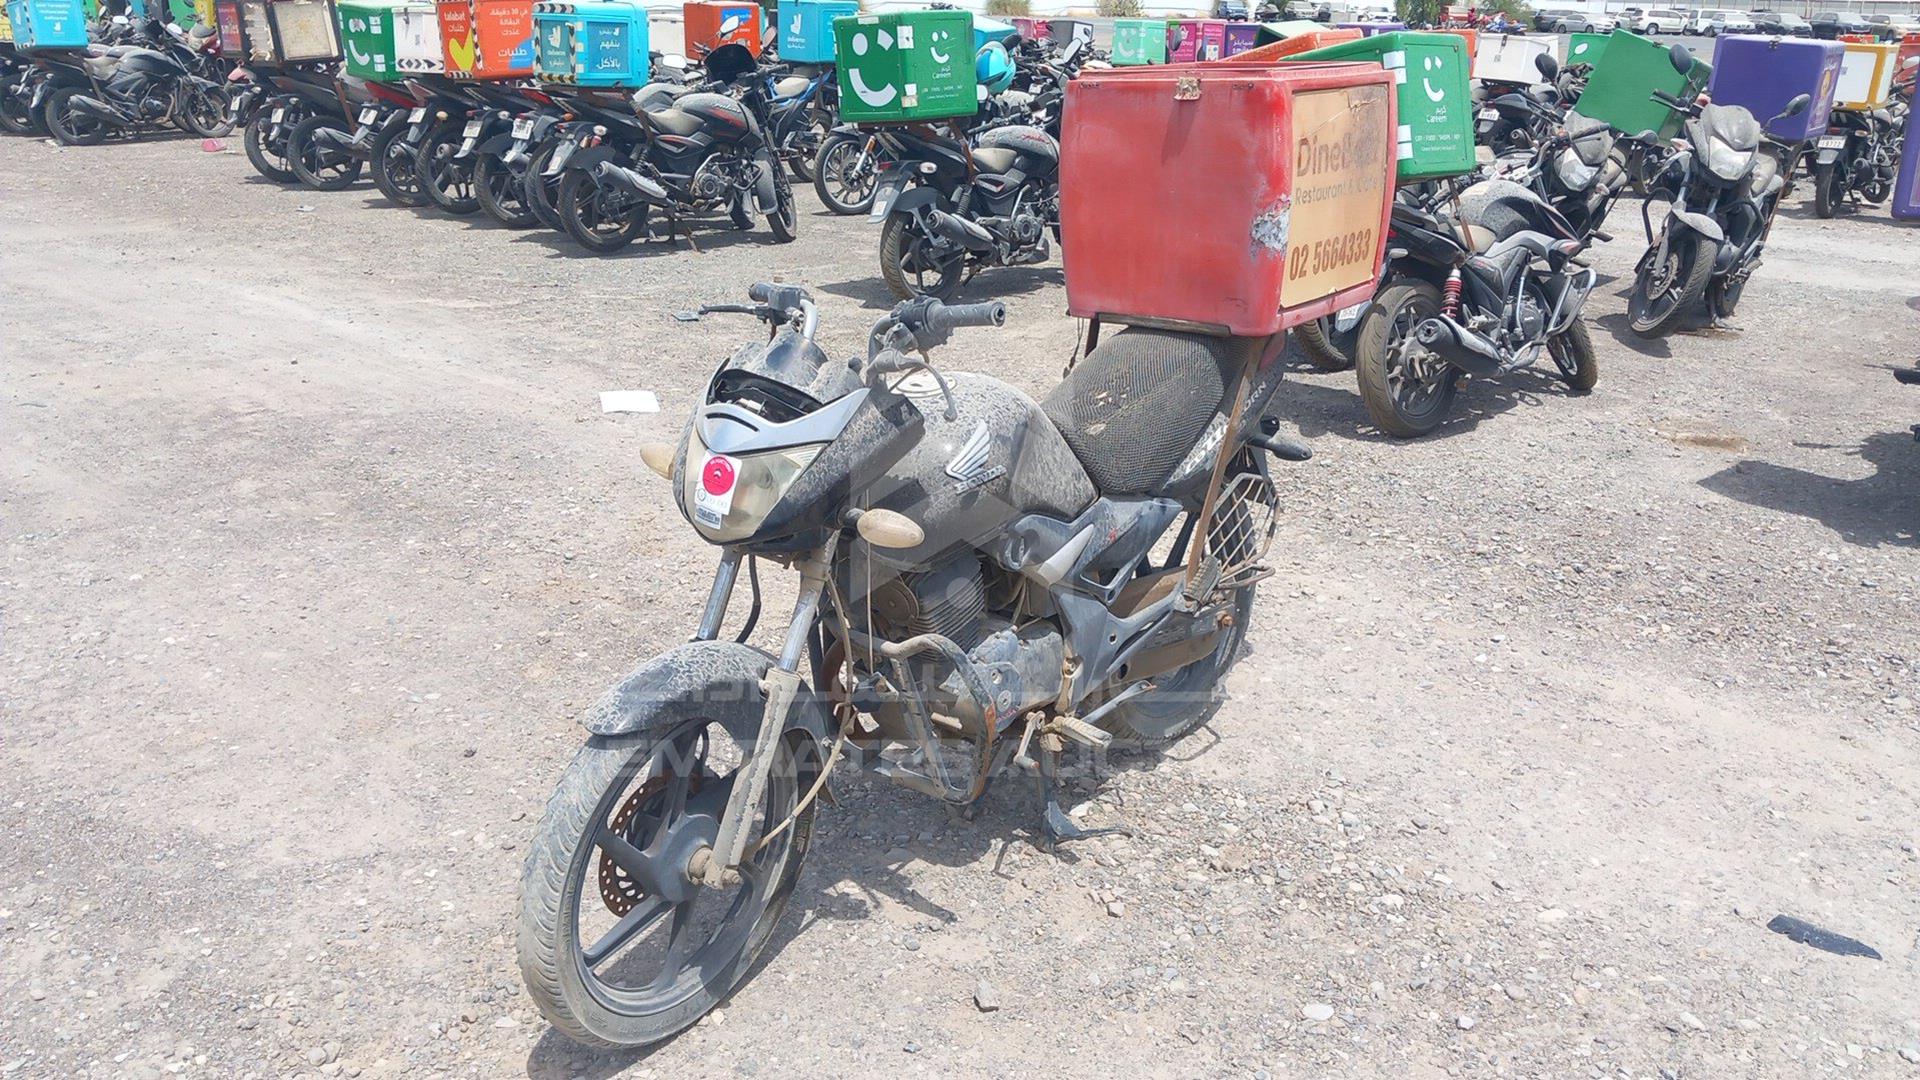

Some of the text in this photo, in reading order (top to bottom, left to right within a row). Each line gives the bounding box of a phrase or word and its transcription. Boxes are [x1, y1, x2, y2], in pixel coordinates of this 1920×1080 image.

[1289, 228, 1371, 281] 02 5664333
[954, 465, 1007, 496] HONDA
